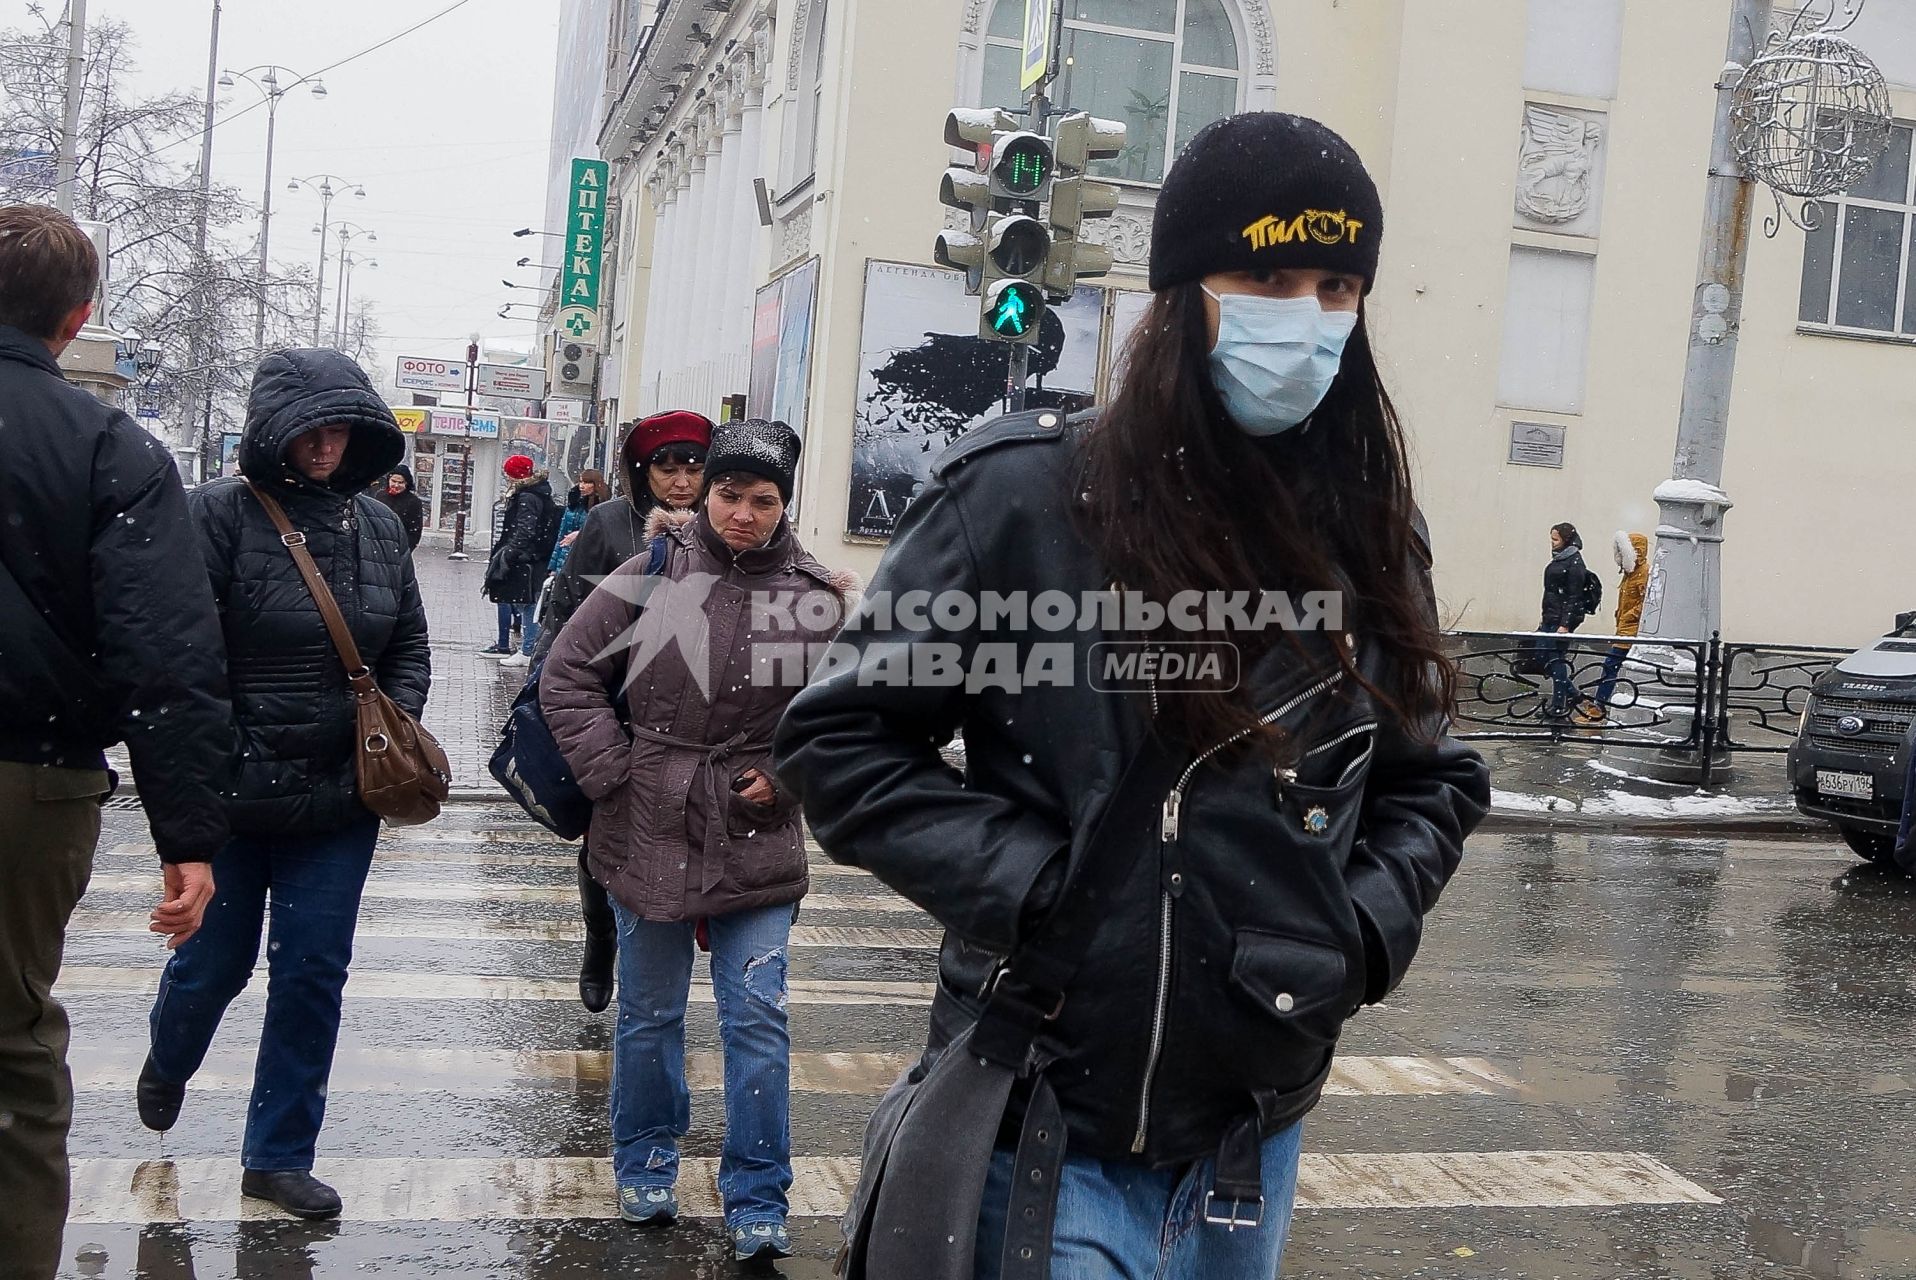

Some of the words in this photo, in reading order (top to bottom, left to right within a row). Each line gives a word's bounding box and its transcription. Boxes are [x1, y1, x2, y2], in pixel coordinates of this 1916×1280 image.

[1014, 153, 1040, 186] 14
[571, 168, 599, 297] АПТЕКА
[404, 361, 445, 374] ФОТО
